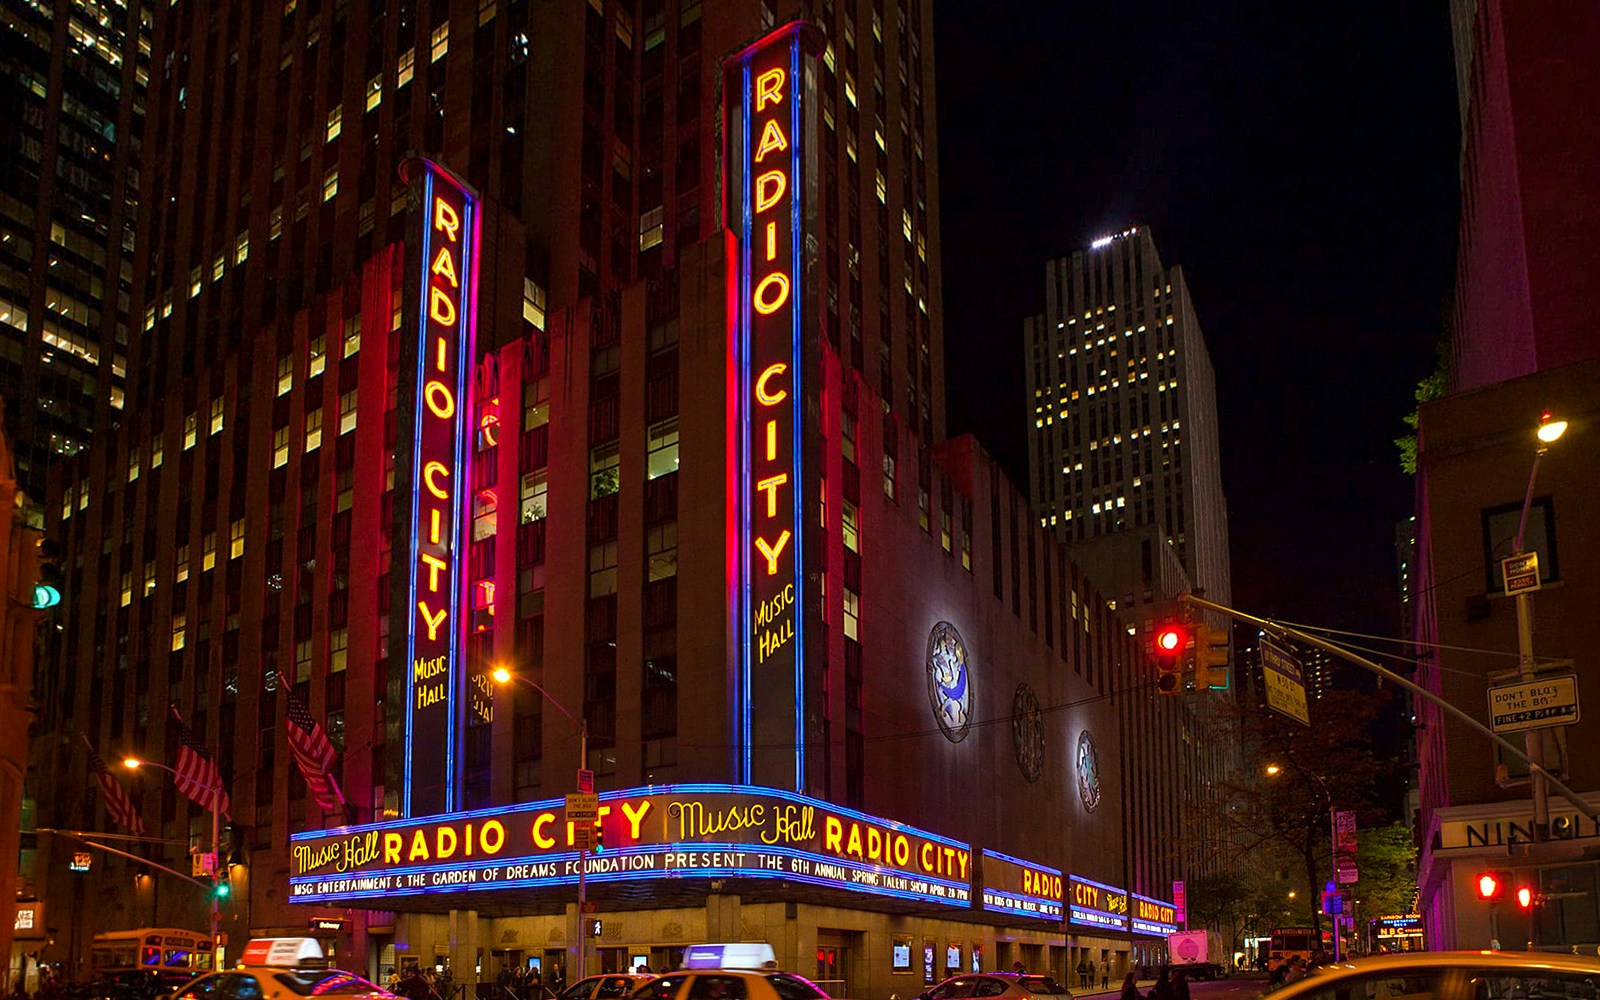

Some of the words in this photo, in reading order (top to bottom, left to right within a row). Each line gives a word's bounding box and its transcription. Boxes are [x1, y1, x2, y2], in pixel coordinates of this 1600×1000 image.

[752, 66, 790, 315] RADIO
[424, 196, 460, 420] RADIO
[754, 362, 791, 576] CITY
[417, 460, 450, 642] CITY
[754, 583, 795, 636] MUSIC
[758, 618, 795, 664] HALL
[413, 655, 447, 693] MUSIC
[1495, 690, 1524, 703] DON'T
[417, 682, 446, 720] HALL
[1507, 700, 1527, 710] THE
[384, 819, 506, 865] RADIO
[666, 801, 766, 841] Music
[760, 805, 816, 845] Hall
[294, 842, 341, 875] Music
[335, 830, 381, 873] Hall
[825, 815, 910, 868] RADIO
[920, 841, 968, 879] CITY
[294, 882, 314, 896] MSG
[317, 876, 392, 894] ENTERTAINMENT
[395, 877, 403, 889] &
[407, 873, 427, 888] THE
[432, 870, 476, 885] GARDEN
[482, 867, 500, 882] OF
[506, 862, 558, 881] DREAMS
[565, 854, 655, 876] FOUNDATION
[665, 852, 746, 870] PRESENT
[757, 853, 784, 871] THE
[791, 858, 810, 874] 6TH
[814, 863, 847, 882] ANNUAL
[851, 870, 879, 887] SPRING
[882, 875, 908, 891] TALENT
[910, 880, 928, 895] SHOW
[929, 884, 947, 899] APRIL
[1023, 868, 1063, 900] RADIO
[1076, 883, 1099, 908] CITY
[1139, 900, 1160, 922] RADIO
[1160, 906, 1175, 925] CITY
[1379, 927, 1404, 936] NBC
